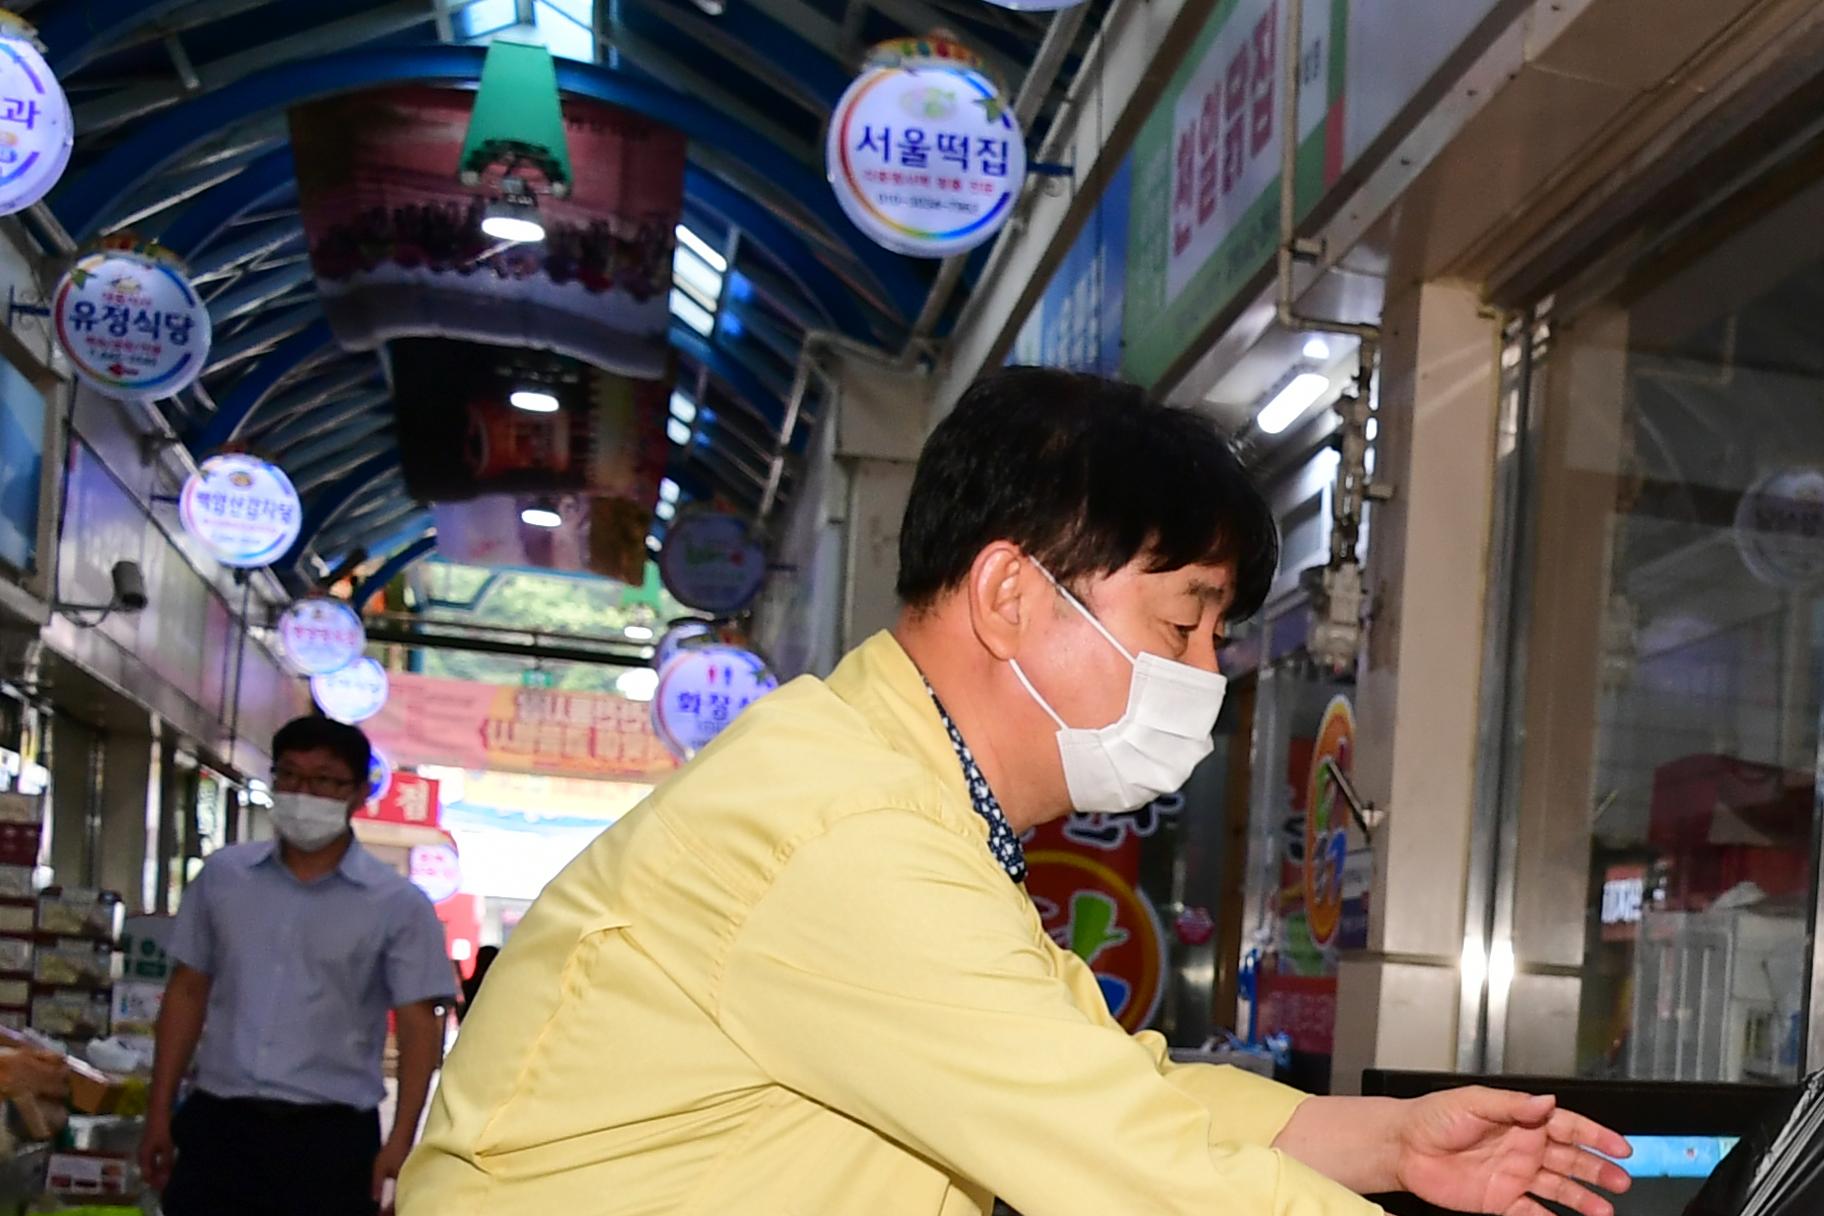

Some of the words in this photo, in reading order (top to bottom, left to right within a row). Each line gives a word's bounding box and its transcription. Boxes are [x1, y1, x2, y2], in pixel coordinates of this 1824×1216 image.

[856, 125, 1009, 178] 서울떡집
[69, 300, 196, 346] 유정식당
[678, 691, 752, 722] 화장
